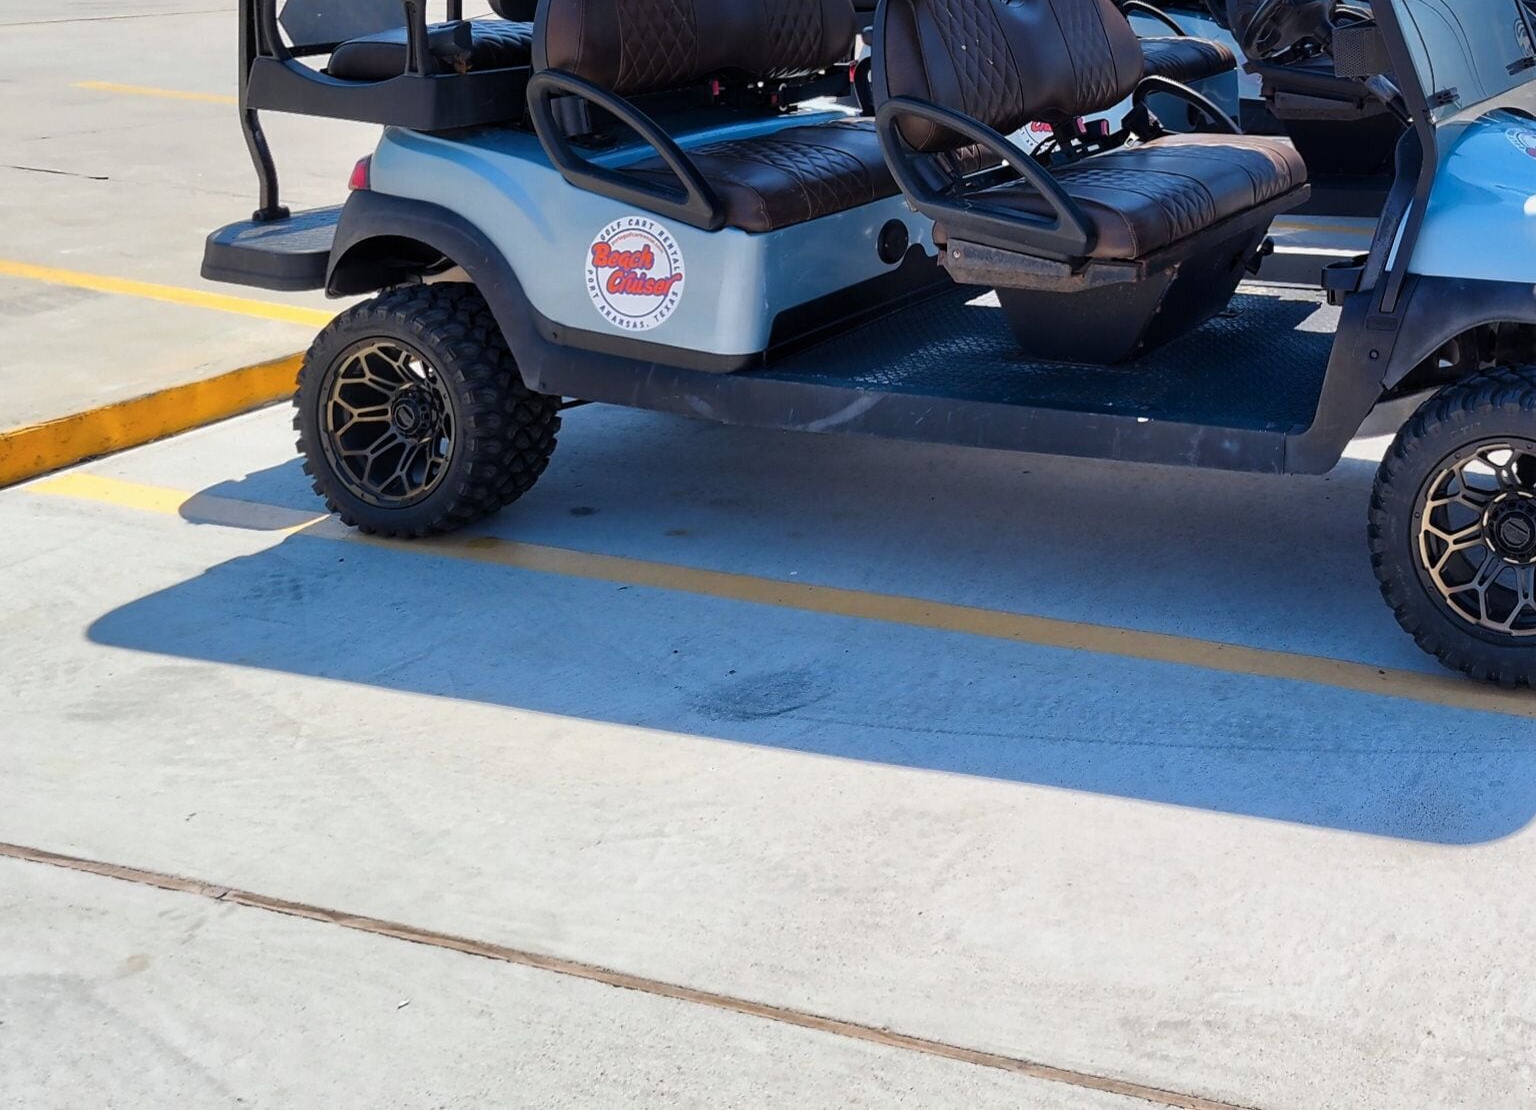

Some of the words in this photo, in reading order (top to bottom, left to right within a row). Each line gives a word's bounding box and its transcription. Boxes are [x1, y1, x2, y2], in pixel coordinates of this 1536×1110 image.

[591, 241, 654, 270] Beach
[600, 222, 621, 241] GOLF
[628, 219, 655, 230] CART
[657, 230, 681, 272] RENTAL
[588, 269, 599, 299] PORT
[654, 291, 678, 322] TEXAS
[606, 269, 683, 296] Cruiser
